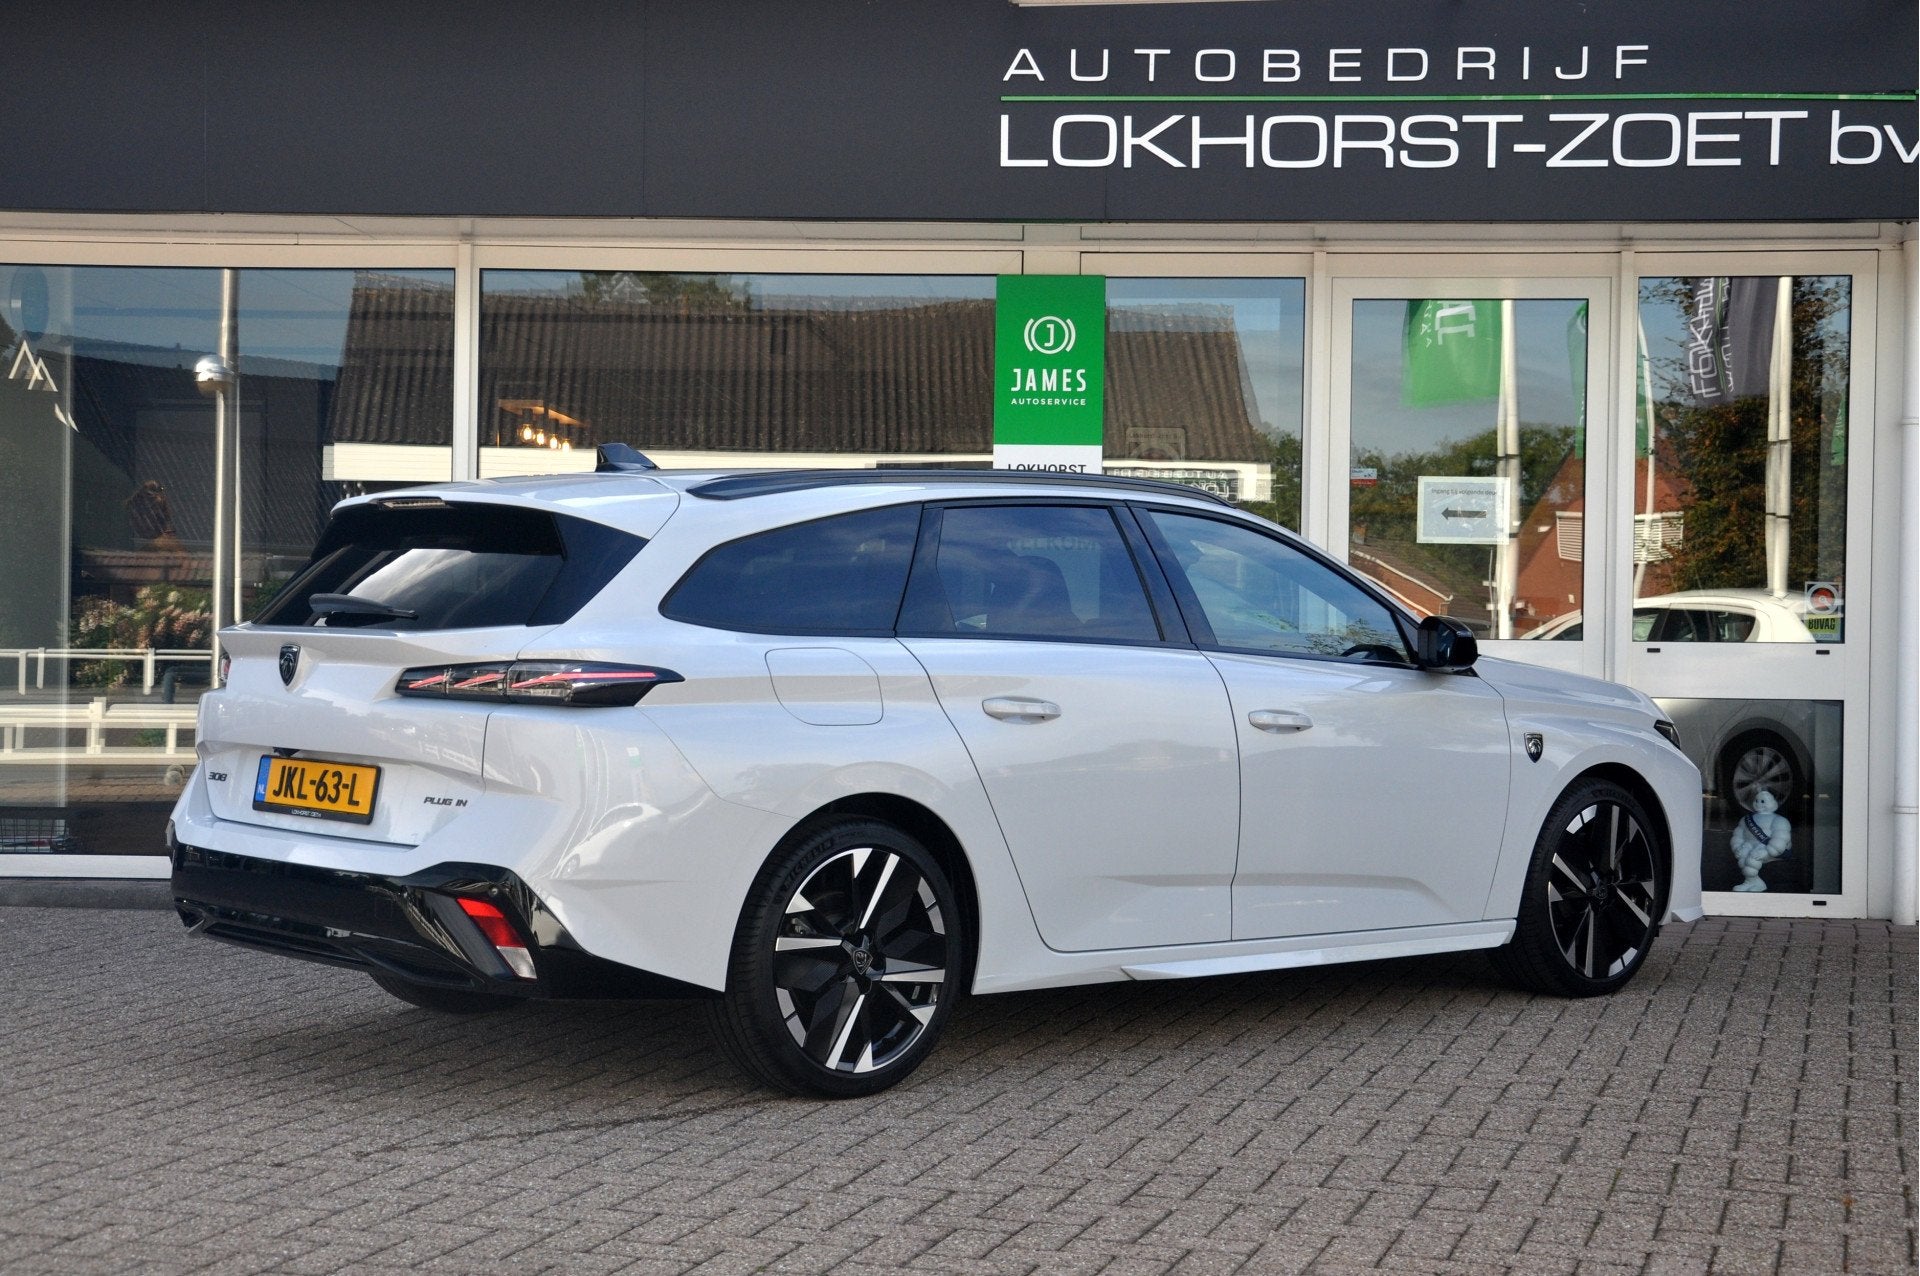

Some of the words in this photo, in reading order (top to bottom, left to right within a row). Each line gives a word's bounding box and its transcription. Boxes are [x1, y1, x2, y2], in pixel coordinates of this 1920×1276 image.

[1002, 44, 1649, 83] AUTOBEDRIJF
[1000, 110, 1808, 169] LOKHORST-ZOET
[1829, 109, 1919, 165] bv
[1010, 368, 1087, 392] JAMES
[1010, 398, 1087, 406] AUTOSERVICE
[1808, 617, 1836, 631] BOVAG
[208, 771, 228, 782] 308
[272, 765, 360, 807] JKL-63-L
[423, 796, 451, 806] PLUG
[452, 797, 468, 807] IN
